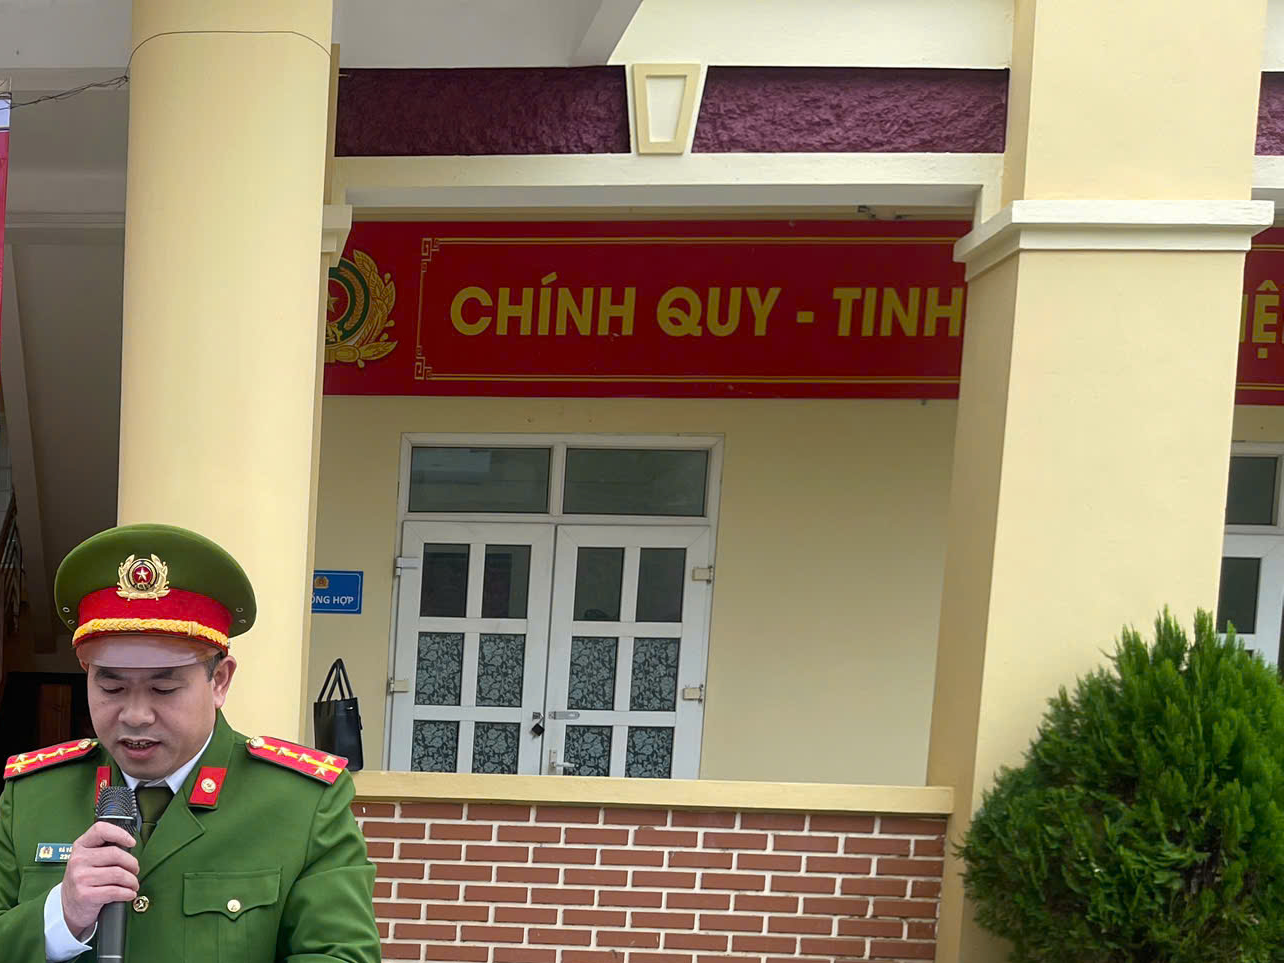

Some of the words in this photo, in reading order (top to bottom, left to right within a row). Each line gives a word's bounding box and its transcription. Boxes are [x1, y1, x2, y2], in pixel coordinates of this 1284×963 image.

[450, 272, 636, 336] CHÍNH
[657, 286, 782, 337] QUY
[796, 311, 814, 323] -
[832, 287, 964, 337] TINH
[333, 595, 354, 606] HỢP
